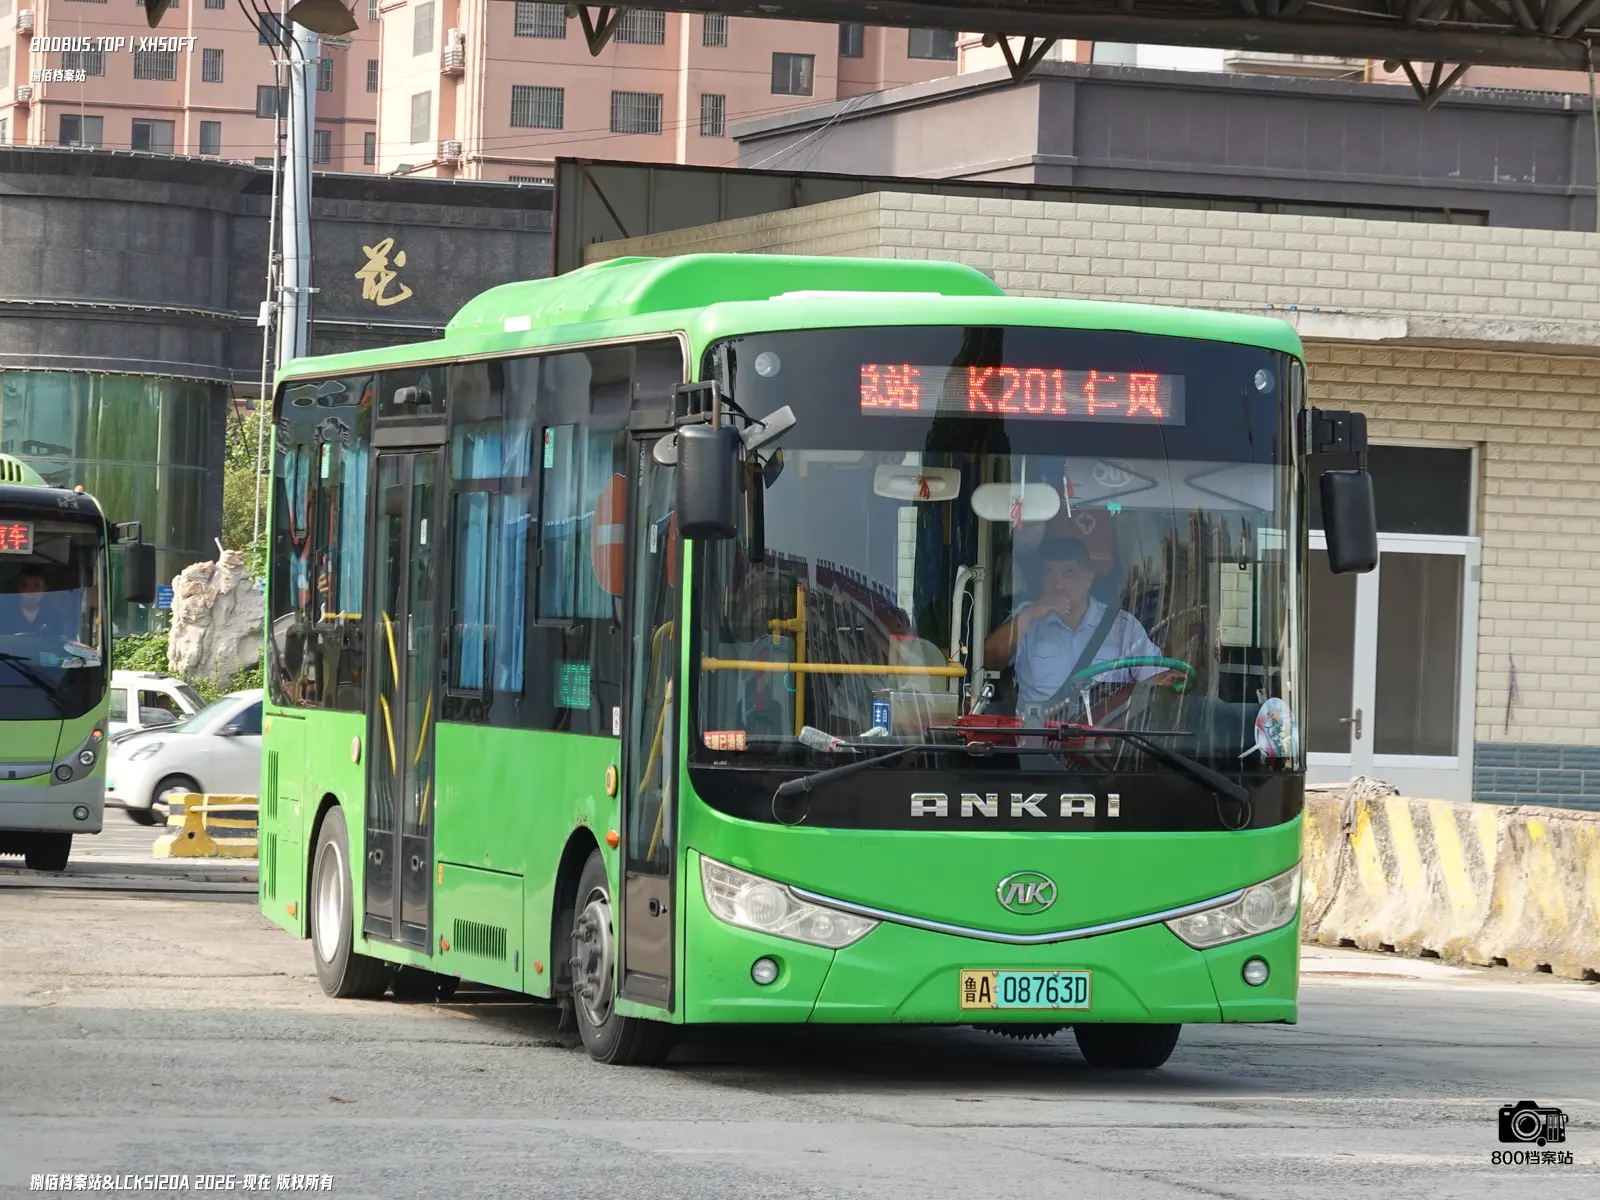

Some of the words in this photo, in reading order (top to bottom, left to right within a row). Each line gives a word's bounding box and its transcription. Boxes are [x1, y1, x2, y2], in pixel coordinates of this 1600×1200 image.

[969, 365, 1066, 415] K201
[1083, 370, 1163, 417] 仁风
[910, 792, 1121, 818] ANKAI
[963, 976, 992, 1003] 鲁A
[1003, 976, 1087, 1003] 08763D
